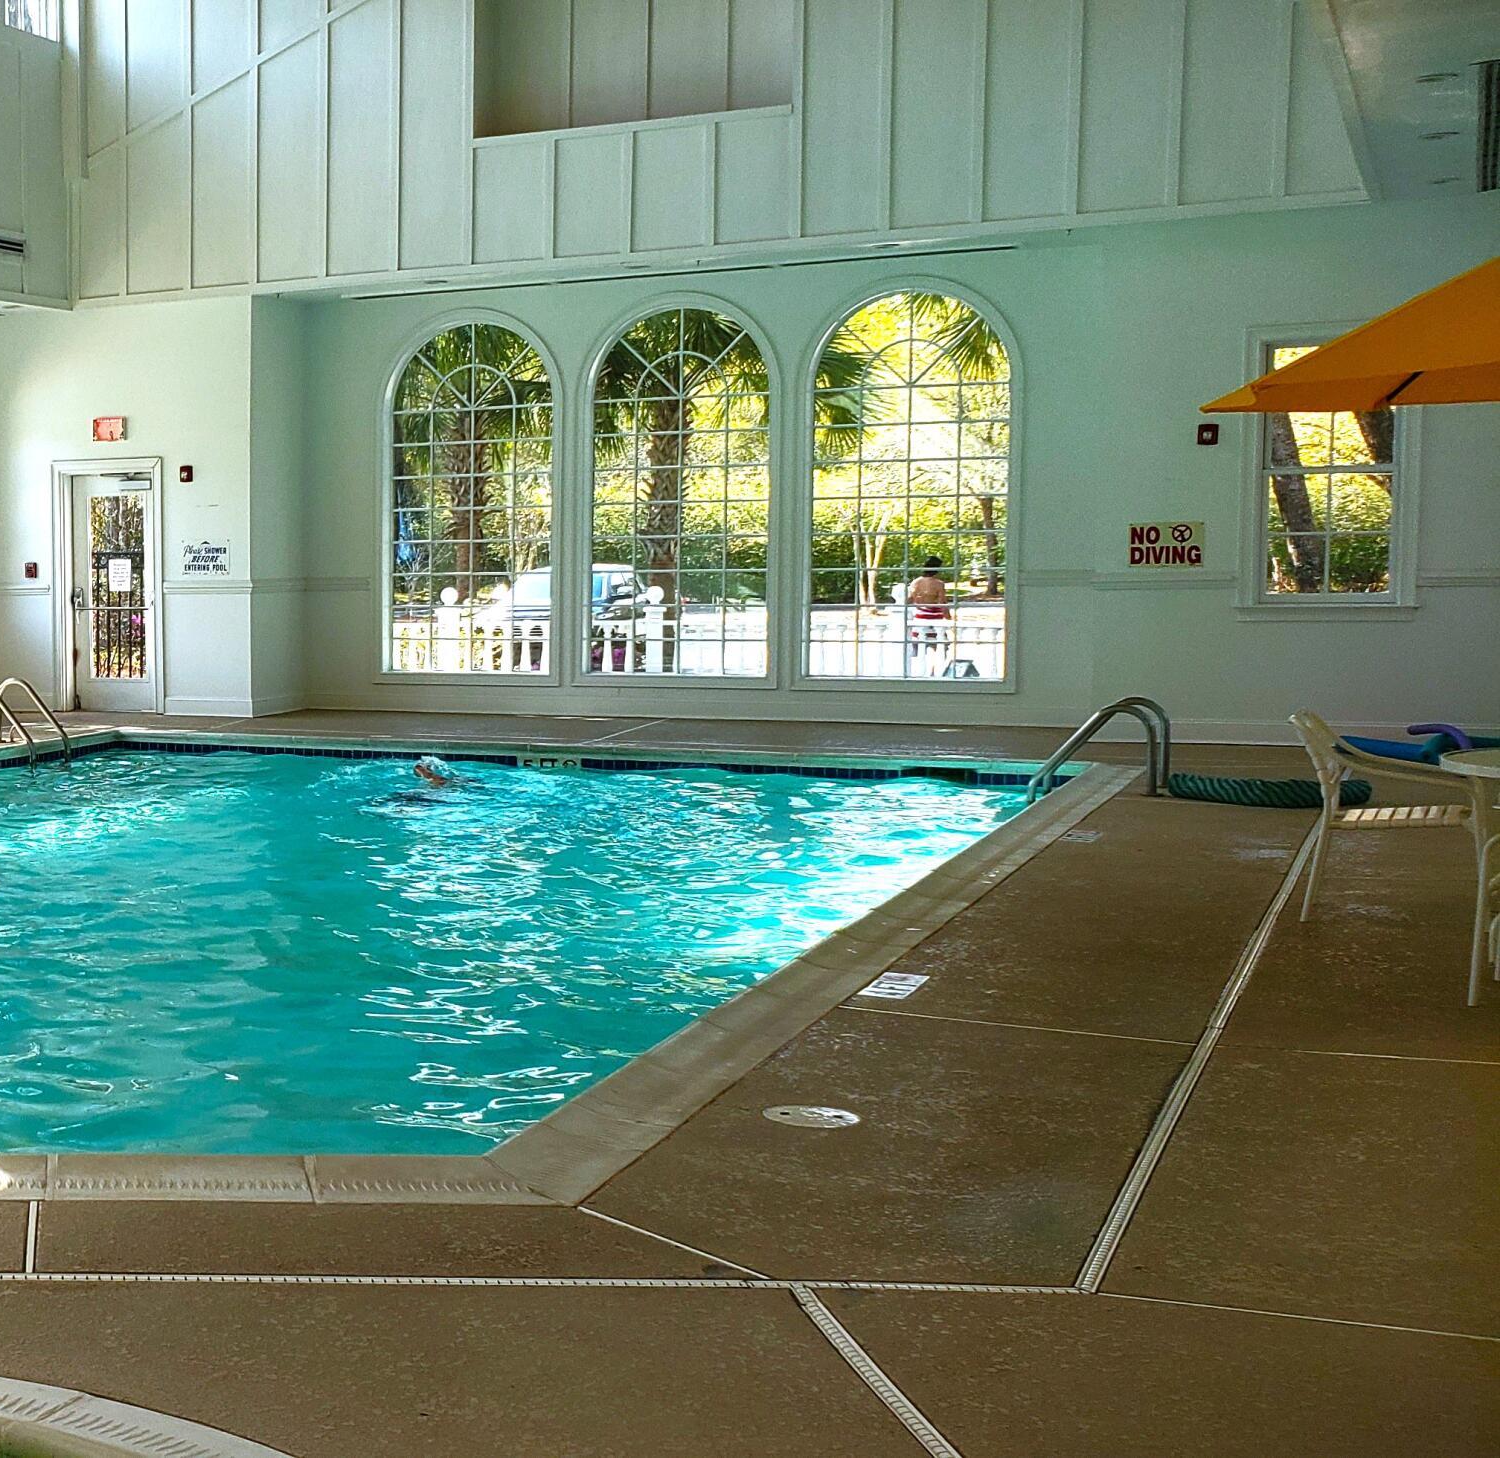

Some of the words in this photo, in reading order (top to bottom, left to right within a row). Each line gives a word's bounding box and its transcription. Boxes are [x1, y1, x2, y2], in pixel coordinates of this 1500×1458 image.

[1130, 526, 1160, 545] NO
[204, 547, 227, 555] SHOWER
[1130, 545, 1202, 565] DIVING
[191, 555, 220, 563] BEFORE
[184, 564, 210, 572] ENTERING
[212, 564, 228, 572] POOL
